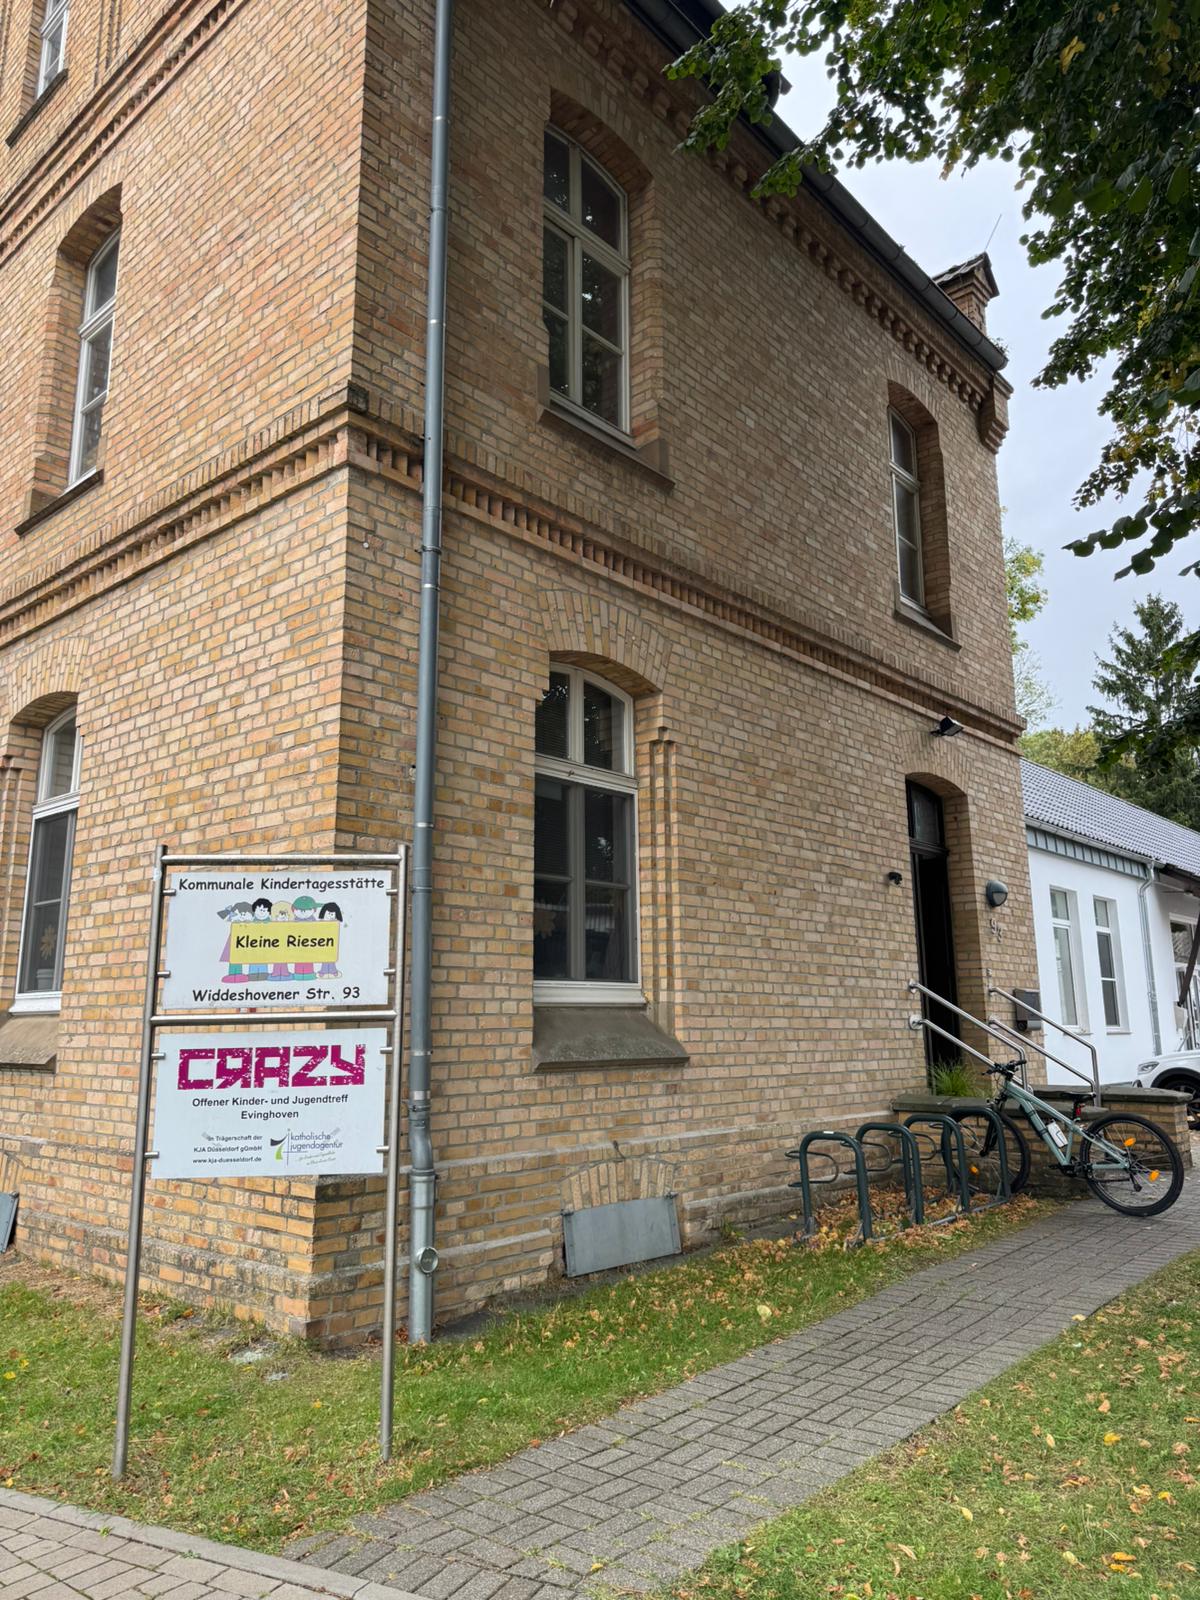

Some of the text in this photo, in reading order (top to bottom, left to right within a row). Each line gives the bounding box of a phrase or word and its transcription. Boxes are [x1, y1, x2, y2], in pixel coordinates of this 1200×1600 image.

[179, 877, 385, 892] Kommunale Kindertagesstätte
[235, 935, 334, 948] Kleine Riesen
[192, 987, 361, 1002] Widdeshovener Str. 93
[177, 1044, 366, 1090] CRAZY
[192, 1094, 348, 1107] Offener Kinder- und Jugendtreff
[241, 1110, 299, 1121] Evinghoven
[290, 1131, 331, 1141] katholische
[290, 1141, 343, 1151] jugendagentur
